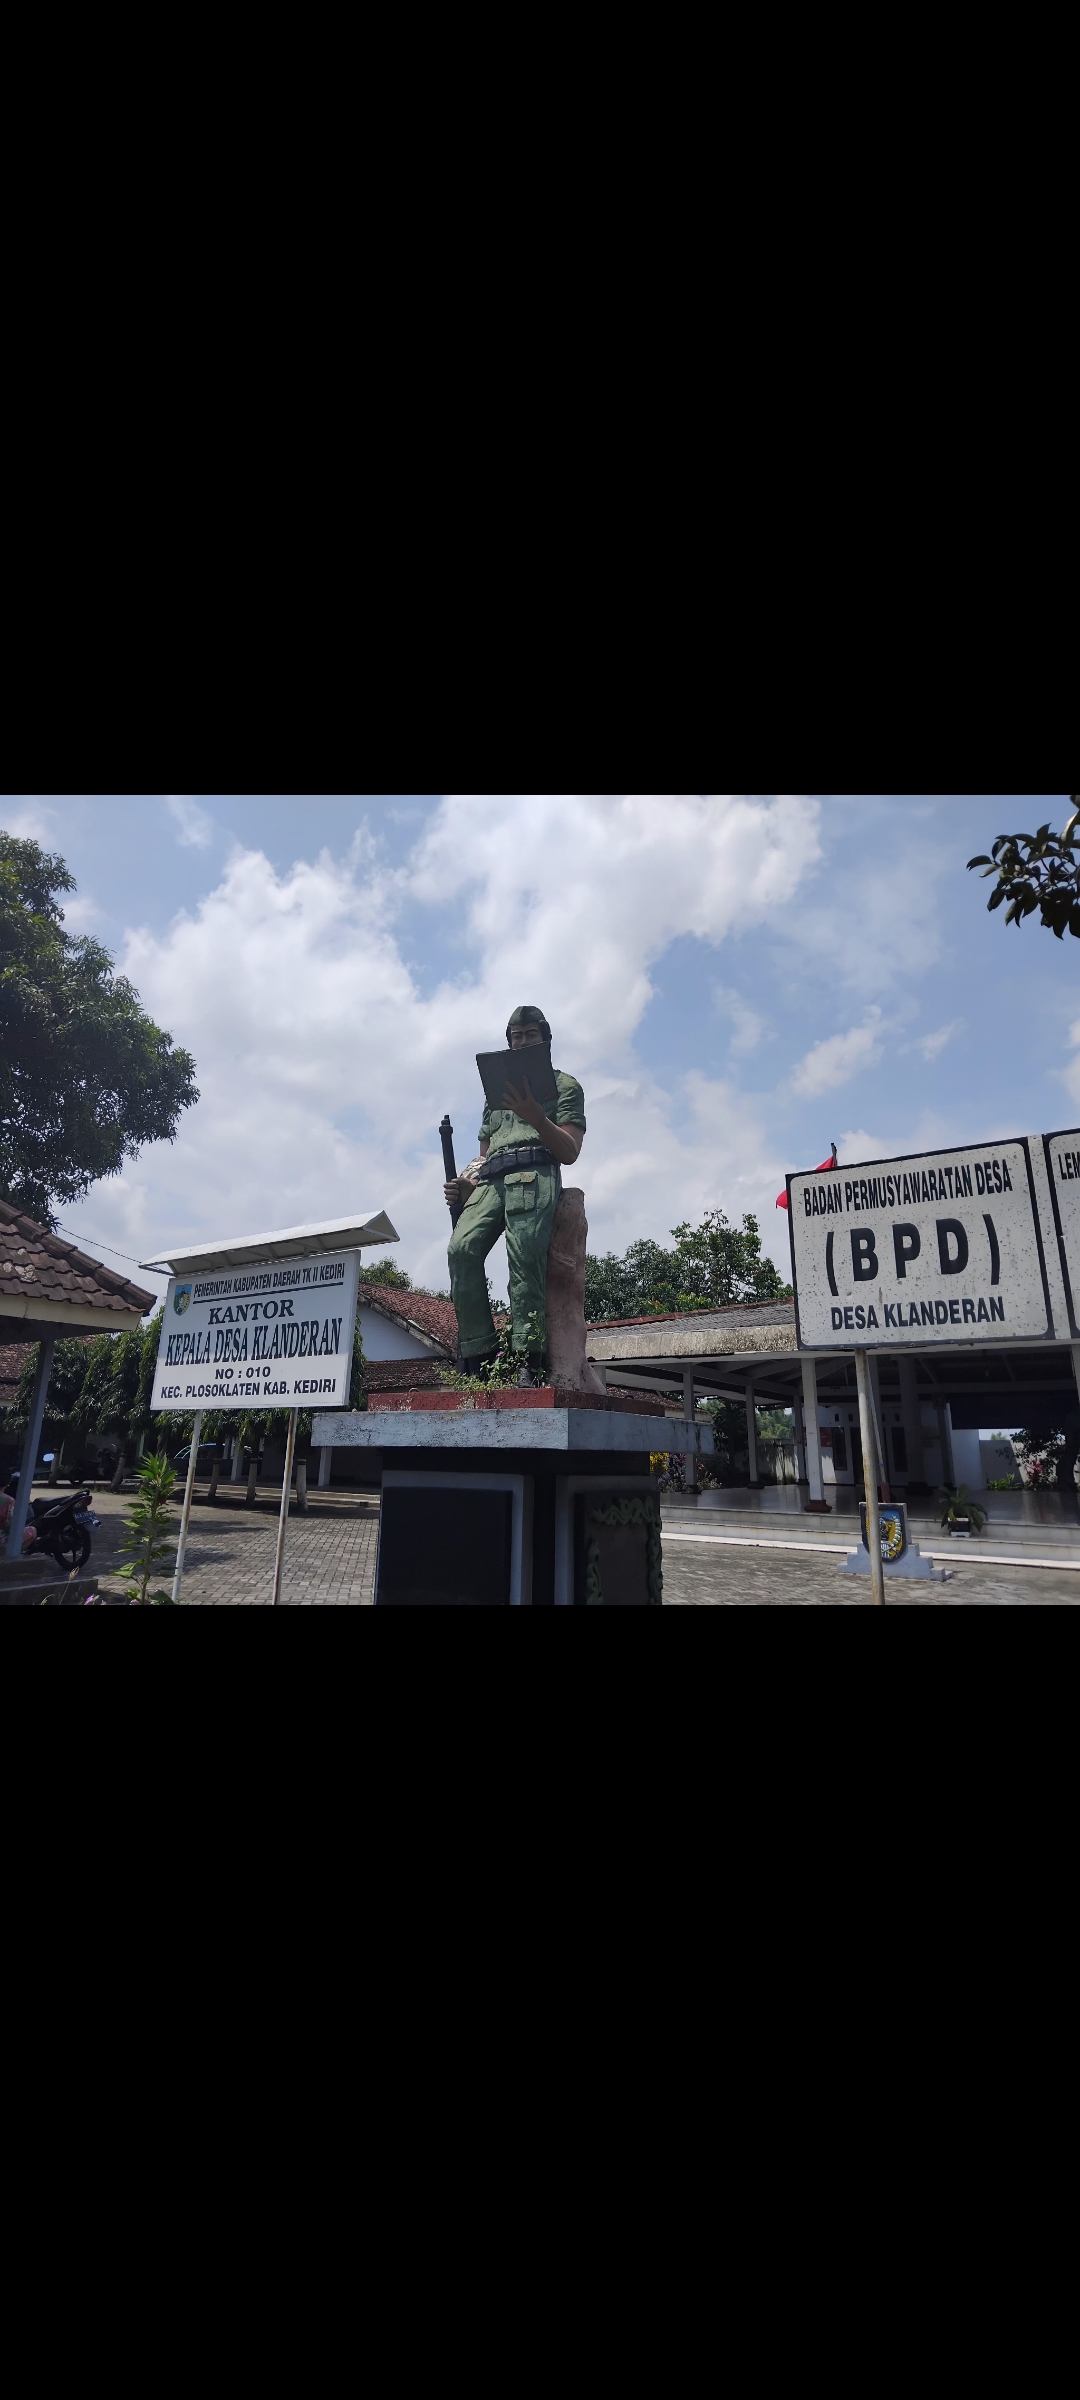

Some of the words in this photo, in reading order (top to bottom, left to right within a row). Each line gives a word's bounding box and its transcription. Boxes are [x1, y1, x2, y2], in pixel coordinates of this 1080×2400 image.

[804, 1187, 843, 1217] BADAN
[846, 1164, 973, 1211] PERMUSYAWARATAN
[975, 1159, 1012, 1195] DESA
[194, 1282, 232, 1297] PEMERINTAH
[233, 1273, 272, 1293] KABUPATEN
[272, 1269, 301, 1289] DAERAH
[301, 1269, 311, 1283] TK
[319, 1263, 345, 1279] KEDIRI
[208, 1299, 294, 1324] KANTOR
[831, 1305, 879, 1330] DESA
[884, 1296, 1005, 1327] KLANDERAN
[165, 1332, 210, 1366] KEPALA
[213, 1327, 249, 1362] DESA
[251, 1318, 342, 1360] KLANDERAN
[161, 1386, 182, 1398] KEC.
[186, 1382, 260, 1398] PLOSOKLATEN
[264, 1380, 290, 1395] KAB.
[294, 1379, 336, 1393] KEDIRI
[215, 1368, 233, 1380] NO
[246, 1366, 271, 1377] 010
